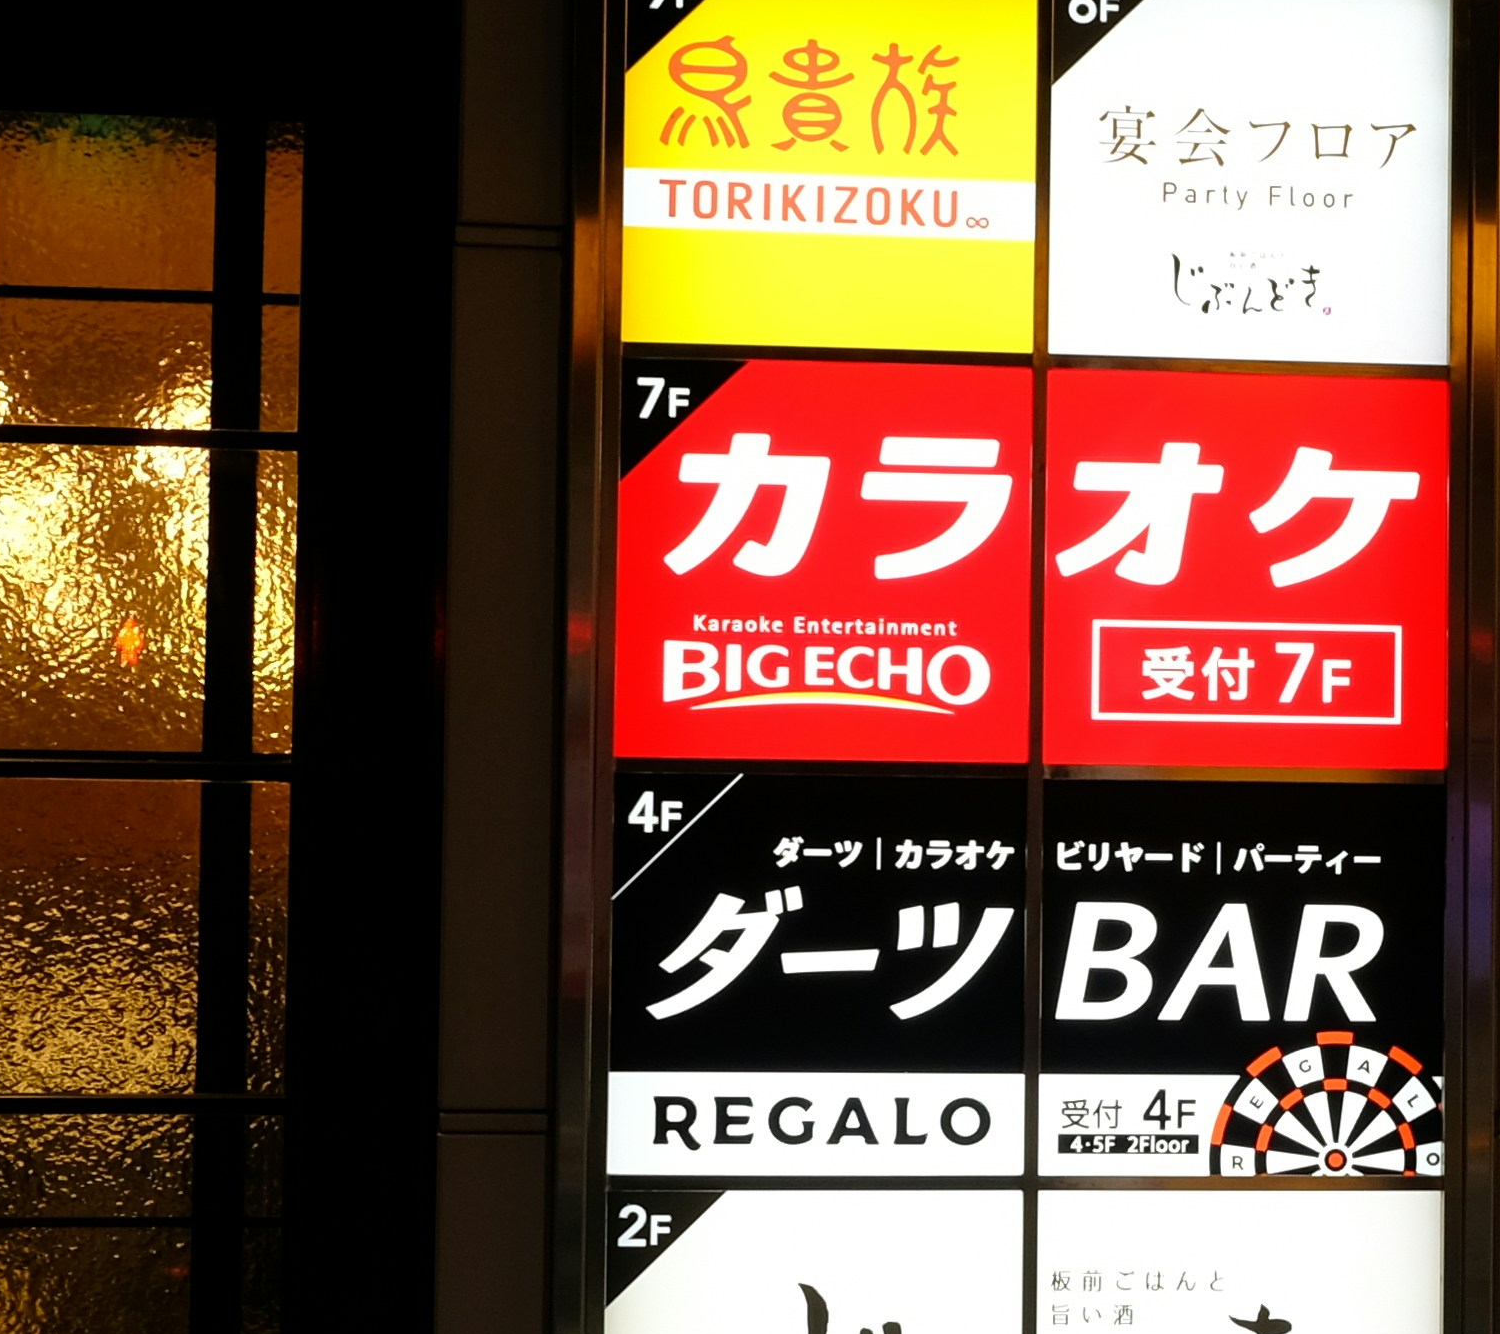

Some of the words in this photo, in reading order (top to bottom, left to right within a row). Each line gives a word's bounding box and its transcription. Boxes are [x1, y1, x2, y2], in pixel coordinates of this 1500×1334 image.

[659, 35, 961, 157] 鳥貴族
[1098, 105, 1418, 170] 宴会フロア
[659, 178, 961, 229] TORIKIZOKU
[1161, 181, 1248, 212] Party
[1268, 185, 1355, 210] Floor
[636, 376, 692, 421] 7F
[692, 614, 784, 635] Karaoke
[793, 616, 958, 639] Entertainment
[663, 640, 791, 705] BIG
[806, 643, 992, 707] ECHO
[1140, 646, 1255, 703] 受付
[1274, 641, 1353, 705] 7F
[627, 790, 684, 835] 4F
[644, 885, 1016, 1022] ダーツ
[1054, 900, 1385, 1023] BAR
[653, 1096, 993, 1153] REGALO
[1061, 1099, 1122, 1130] 受付
[1142, 1088, 1197, 1131] 4F
[1126, 1135, 1190, 1155] 2Floor
[617, 1205, 672, 1248] 2F
[1051, 1270, 1224, 1293] 板前ごはんと
[1051, 1304, 1134, 1326] 旨い酒
